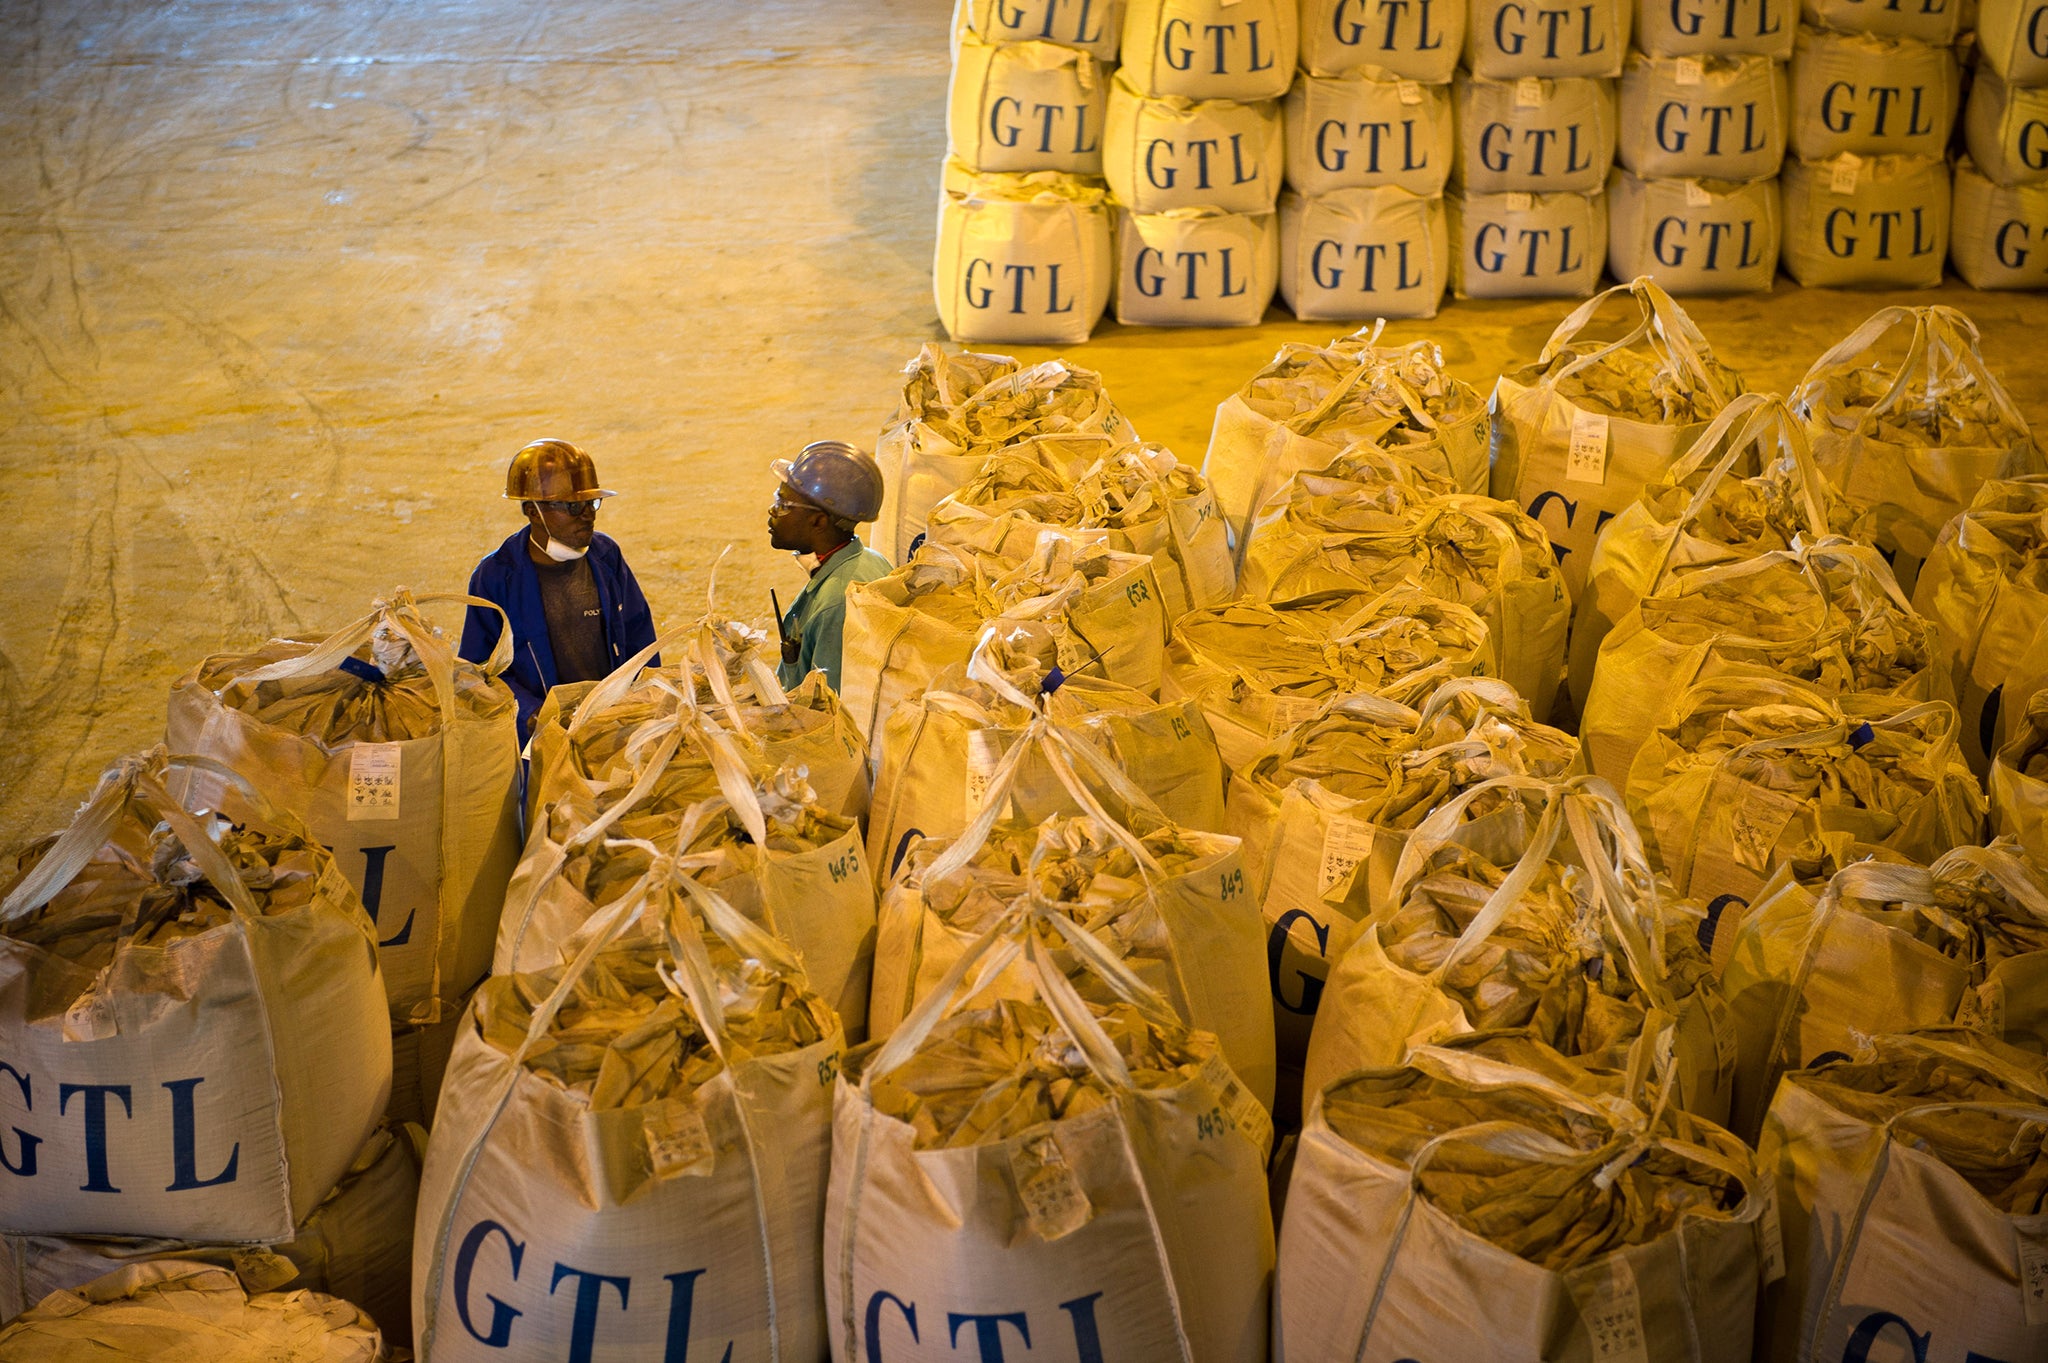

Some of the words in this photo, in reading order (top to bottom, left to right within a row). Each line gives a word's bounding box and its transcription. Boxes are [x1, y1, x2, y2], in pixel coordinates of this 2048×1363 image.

[1164, 18, 1274, 75] GTL
[1332, 0, 1443, 51] GTL
[1493, 3, 1605, 59] GTL
[1670, 0, 1781, 39] GTL
[990, 96, 1097, 154] GTL
[1655, 101, 1767, 156] GTL
[1821, 80, 1933, 137] GTL
[1146, 133, 1259, 190] GTL
[1316, 119, 1428, 173] GTL
[1480, 122, 1592, 176] GTL
[1474, 223, 1584, 277] GTL
[1653, 215, 1762, 271] GTL
[1825, 206, 1935, 260] GTL
[965, 257, 1074, 314] GTL
[1134, 246, 1247, 300] GTL
[1312, 239, 1422, 292] GTL
[454, 1219, 738, 1363] GTL
